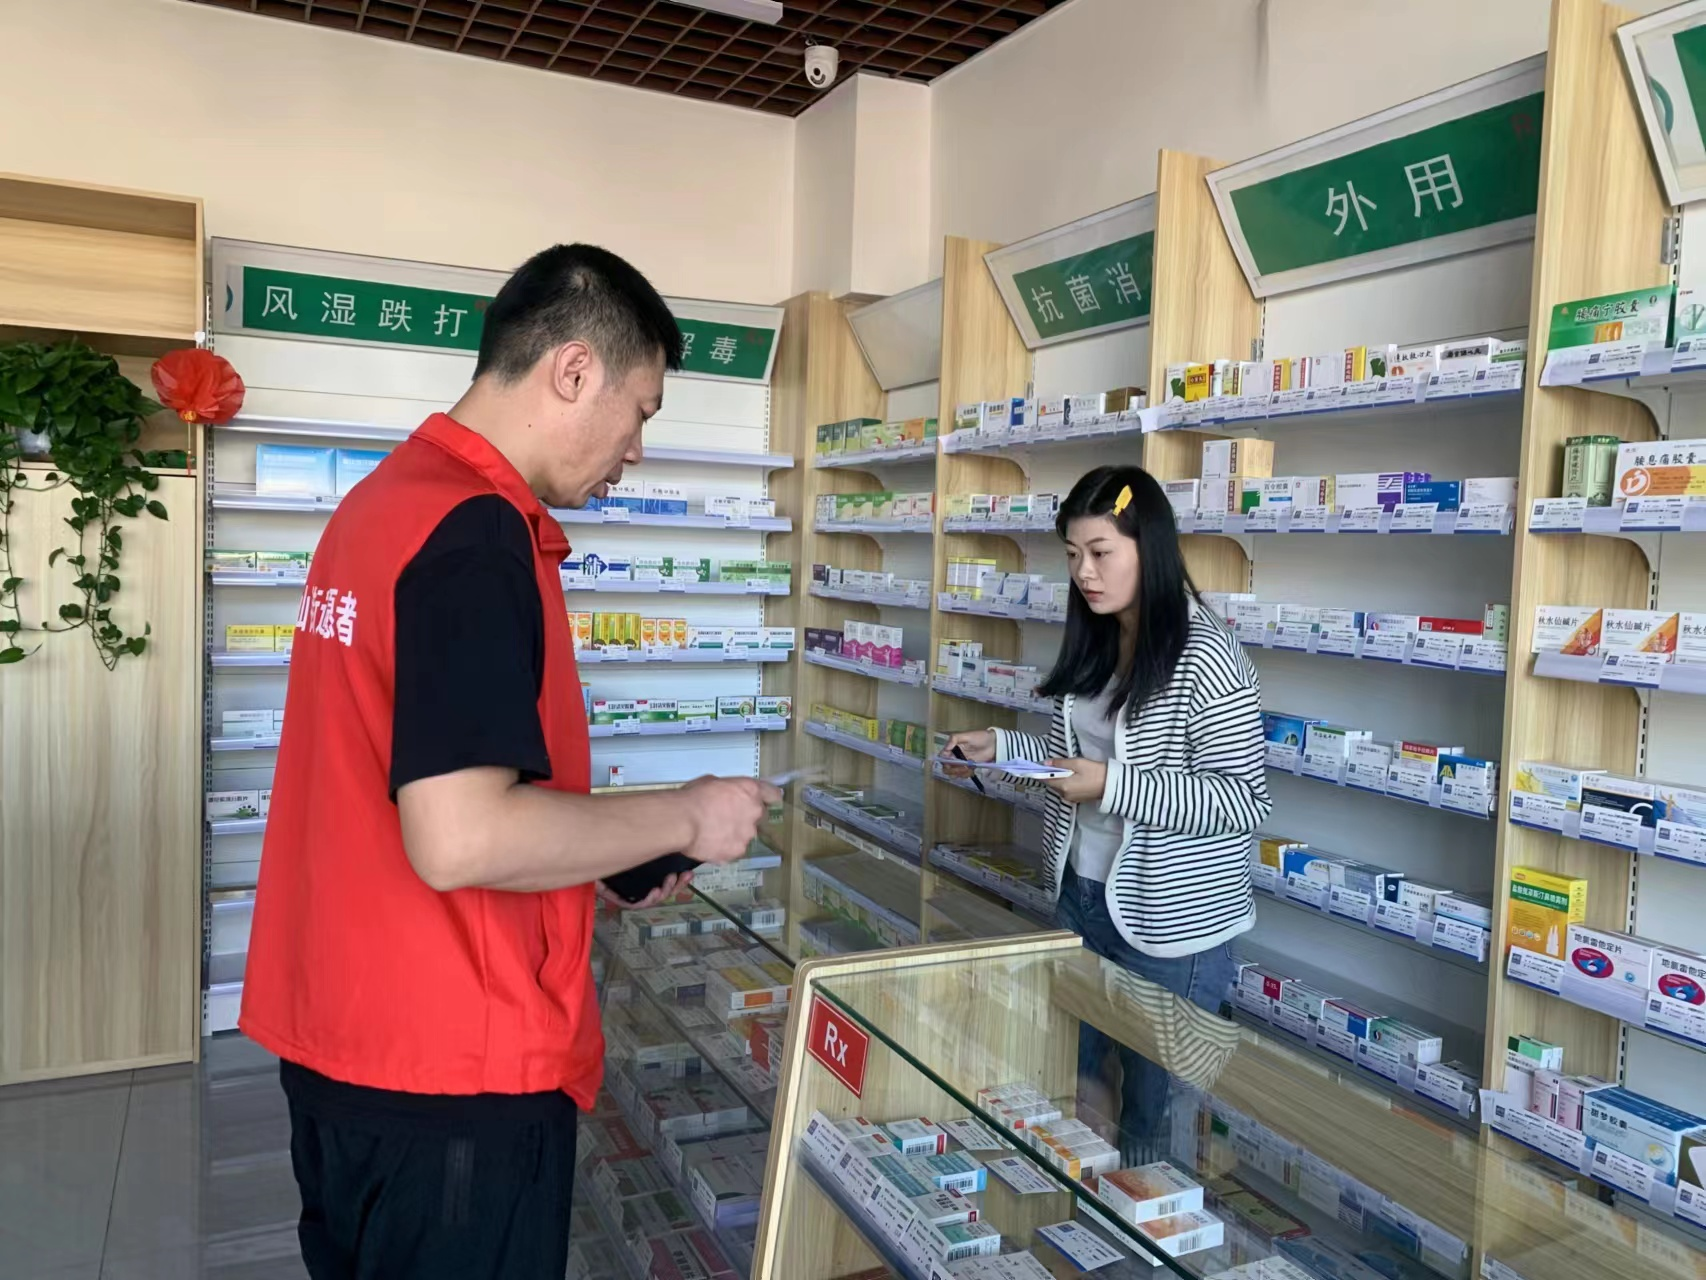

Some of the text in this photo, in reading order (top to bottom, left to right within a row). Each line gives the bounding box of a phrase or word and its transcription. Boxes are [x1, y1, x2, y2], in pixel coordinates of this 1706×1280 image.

[1324, 153, 1465, 237] 外用
[261, 285, 469, 339] 风湿跌打
[1031, 262, 1143, 325] 抗菌消
[1538, 615, 1580, 627] 秋水仙碱片
[1605, 619, 1652, 632] 秋水仙碱片
[823, 1021, 849, 1067] Rx
[1590, 1107, 1628, 1130] 甜梦胶囊
